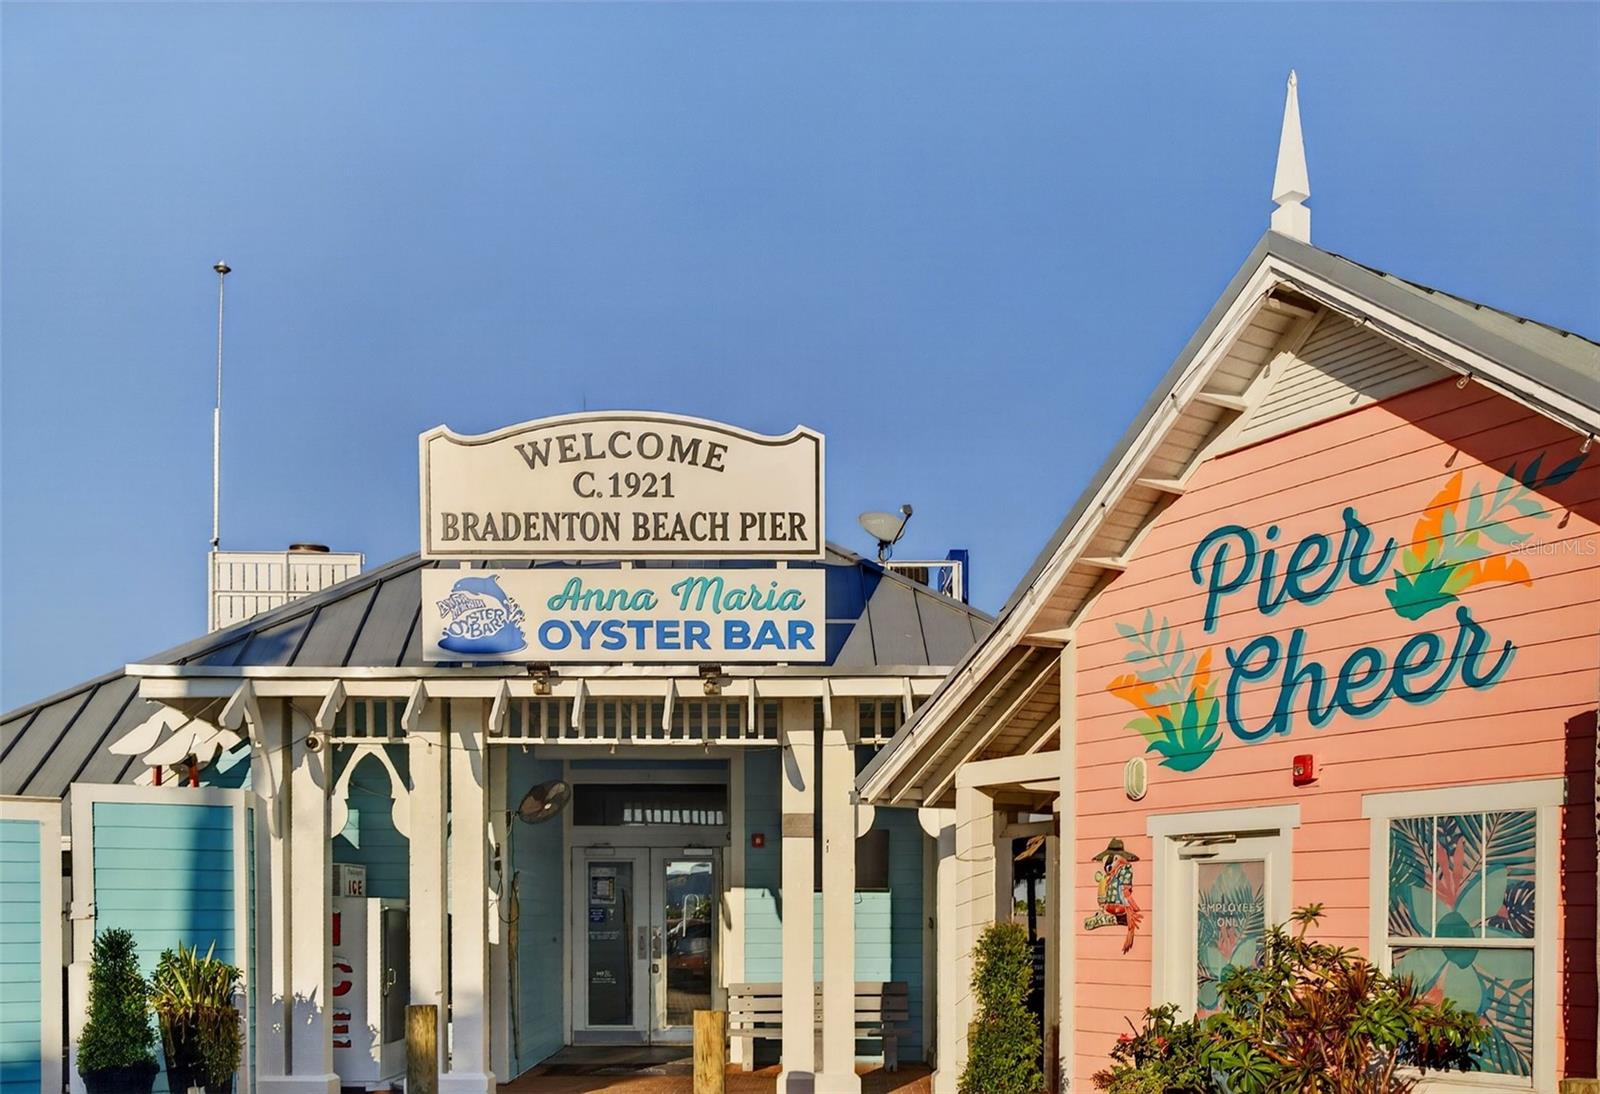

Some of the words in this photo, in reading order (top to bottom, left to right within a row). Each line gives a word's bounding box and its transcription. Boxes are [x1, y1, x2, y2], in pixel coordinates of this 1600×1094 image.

[514, 431, 728, 472] WELCOME
[441, 511, 621, 542] BRADENTON
[632, 512, 730, 542] BEACH
[740, 511, 808, 541] PIER
[1190, 506, 1398, 633] Pier
[547, 576, 657, 612] Anna
[671, 576, 807, 614] Maria
[449, 608, 505, 636] OYSTER
[470, 619, 503, 637] BAR
[538, 619, 711, 650] OYSTER
[724, 620, 815, 650] BAR
[1225, 605, 1518, 743] Cheer
[348, 879, 363, 896] ICE
[1200, 903, 1263, 914] EMPLOYEES
[1217, 917, 1246, 928] ONLY
